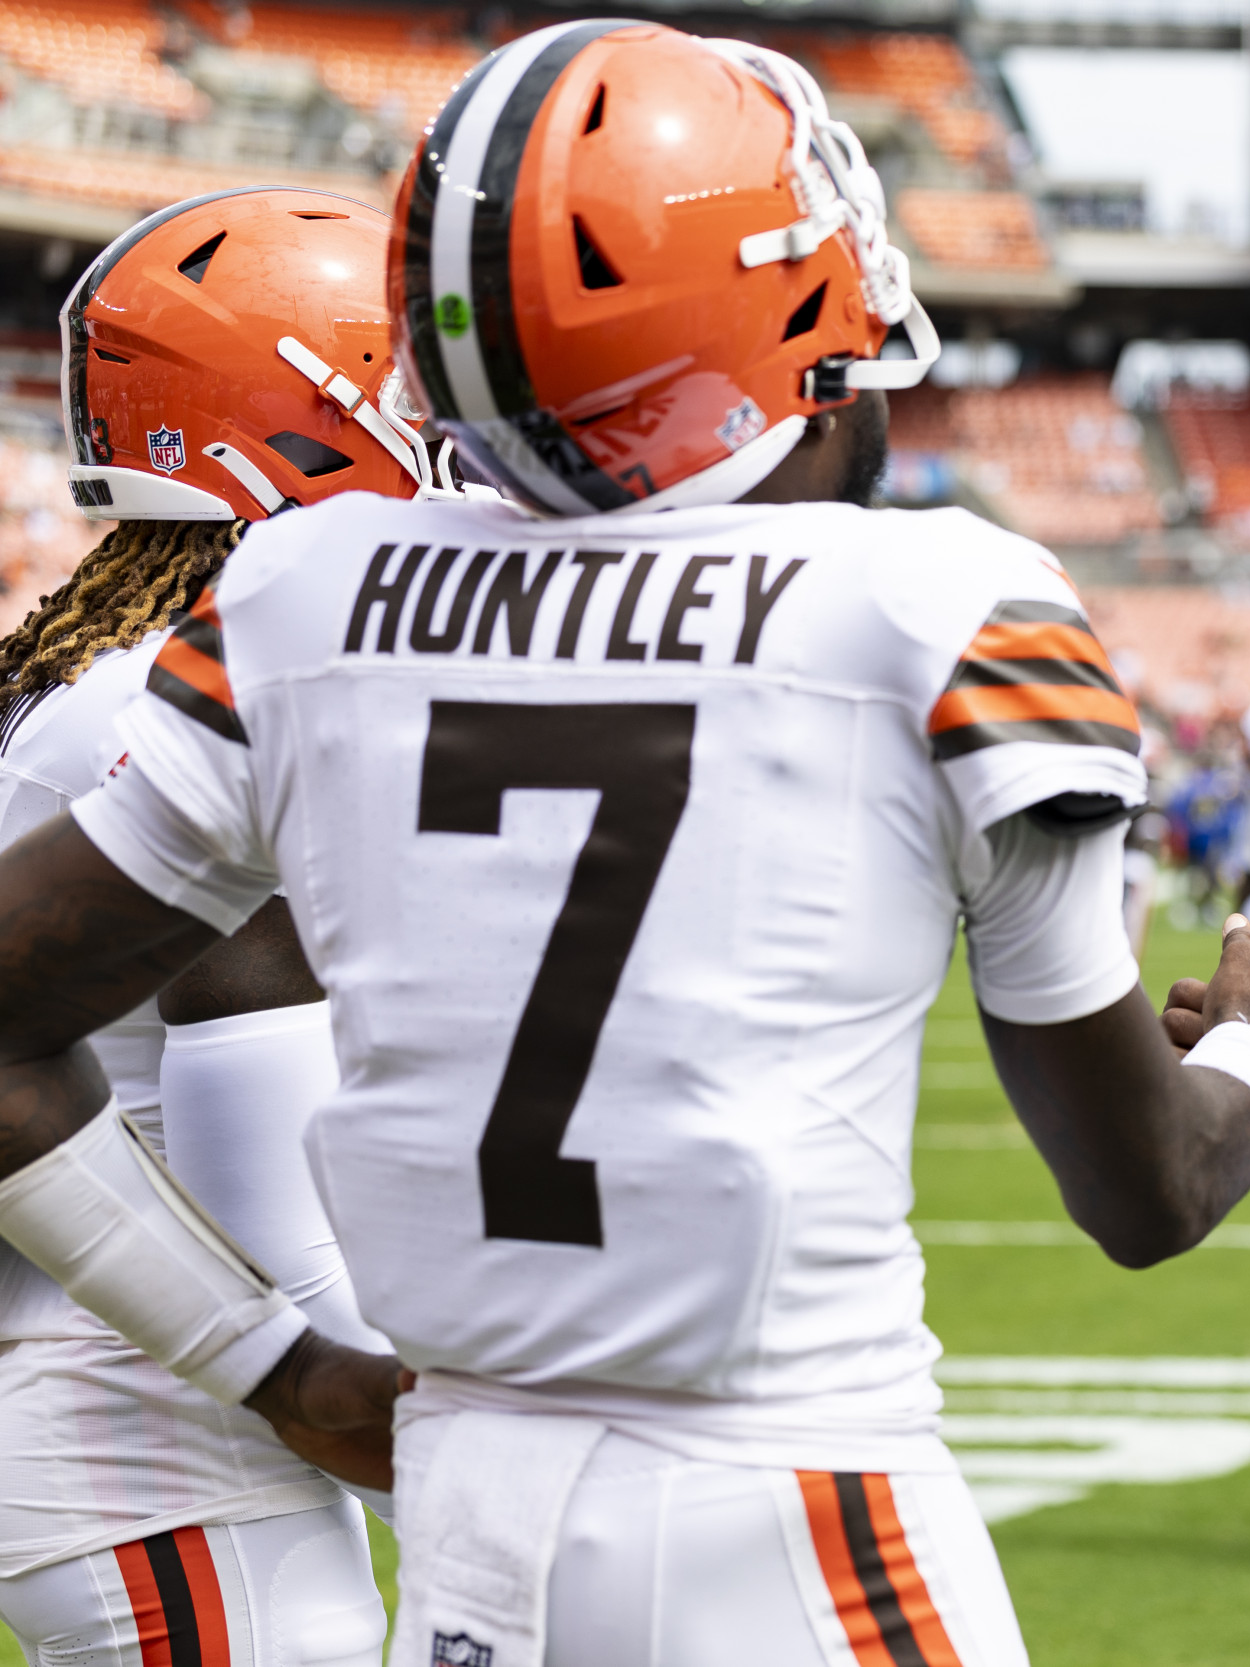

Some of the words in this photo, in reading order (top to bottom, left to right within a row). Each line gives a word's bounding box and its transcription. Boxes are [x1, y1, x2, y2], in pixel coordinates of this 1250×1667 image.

[154, 447, 181, 466] NFL
[619, 461, 658, 495] 7
[343, 544, 808, 665] HUNTLEY
[418, 699, 697, 1249] 7
